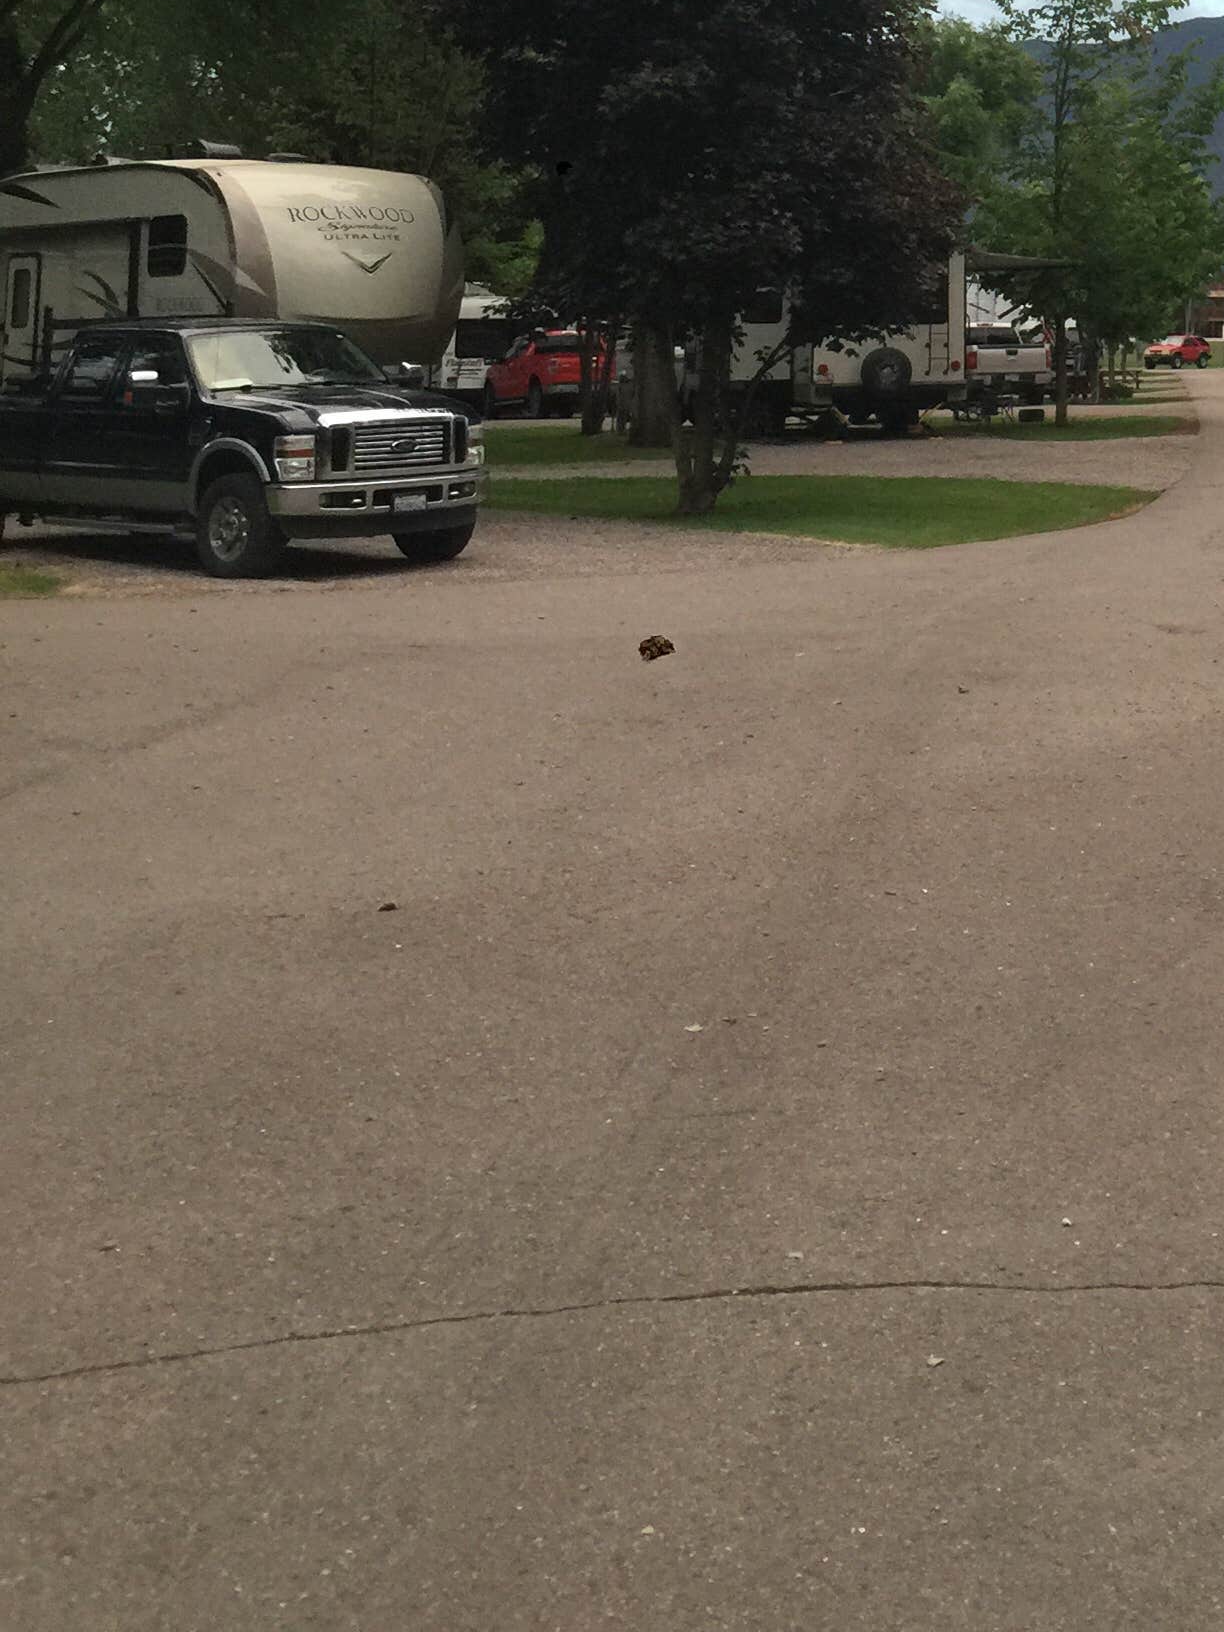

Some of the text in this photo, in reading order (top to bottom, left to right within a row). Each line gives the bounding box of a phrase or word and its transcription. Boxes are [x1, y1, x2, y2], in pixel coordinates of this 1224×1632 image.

[286, 206, 415, 224] ROCKWOOD
[324, 233, 401, 242] ULTRA LITE
